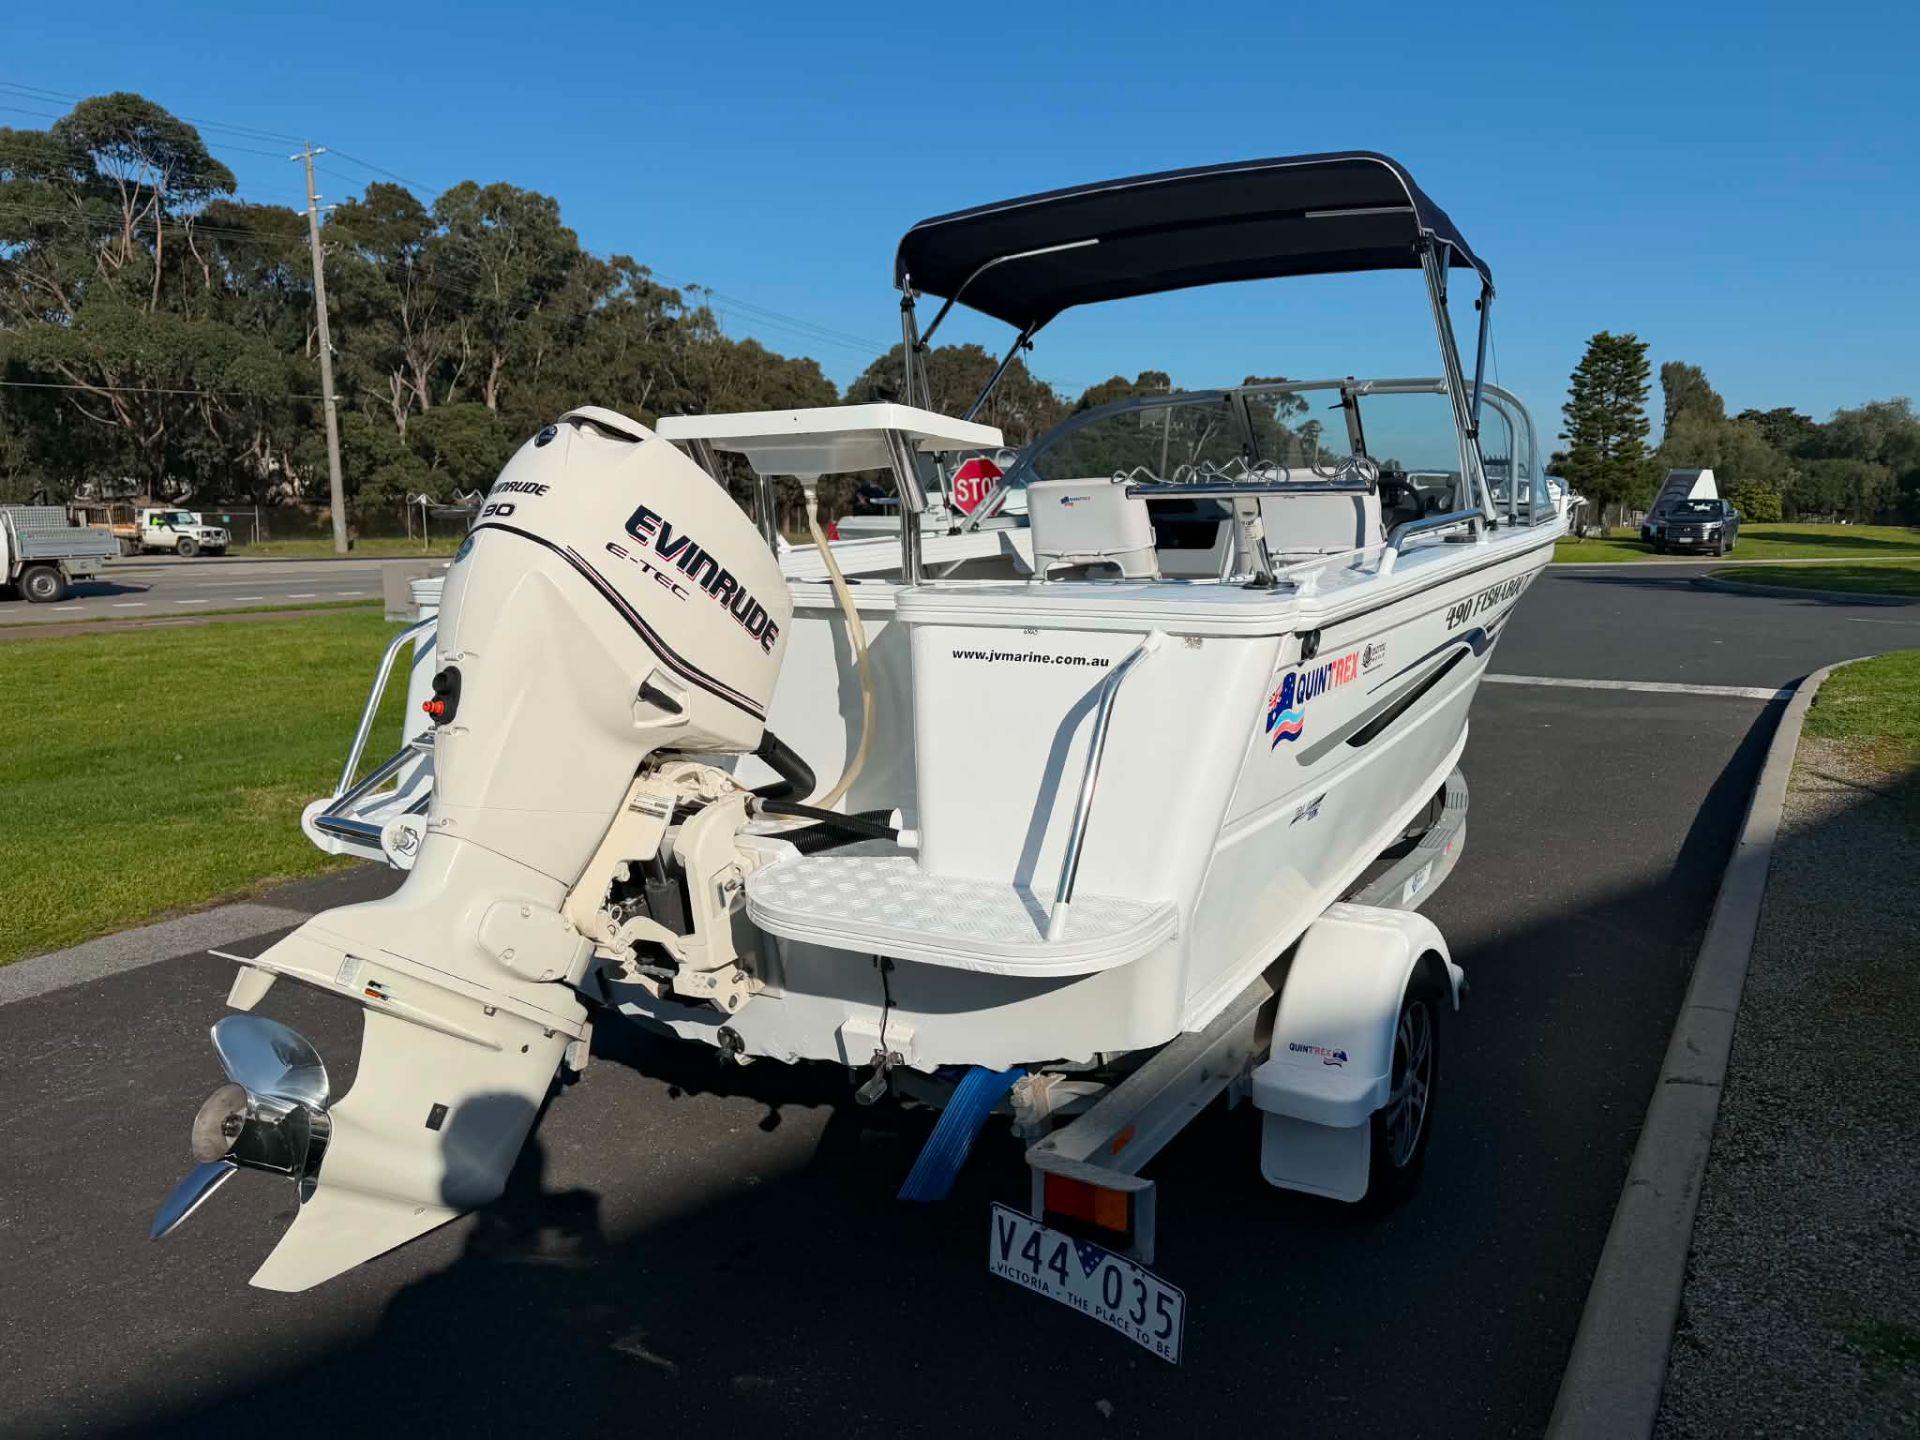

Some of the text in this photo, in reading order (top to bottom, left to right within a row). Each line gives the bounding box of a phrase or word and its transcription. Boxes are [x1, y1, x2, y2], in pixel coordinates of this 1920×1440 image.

[482, 503, 515, 517] 90
[605, 542, 690, 602] E-TEC
[625, 504, 779, 655] EVINRUDE
[1446, 598, 1473, 630] 490
[952, 650, 1109, 667] www.jvmarine.com.au
[1296, 651, 1360, 704] QUINTREX
[997, 1214, 1174, 1340] V44 035
[997, 1261, 1050, 1294] VICTORIA
[1067, 1292, 1089, 1311] THE
[1095, 1305, 1129, 1332] PLACE
[1136, 1327, 1149, 1344] TO
[1157, 1341, 1170, 1357] BE
